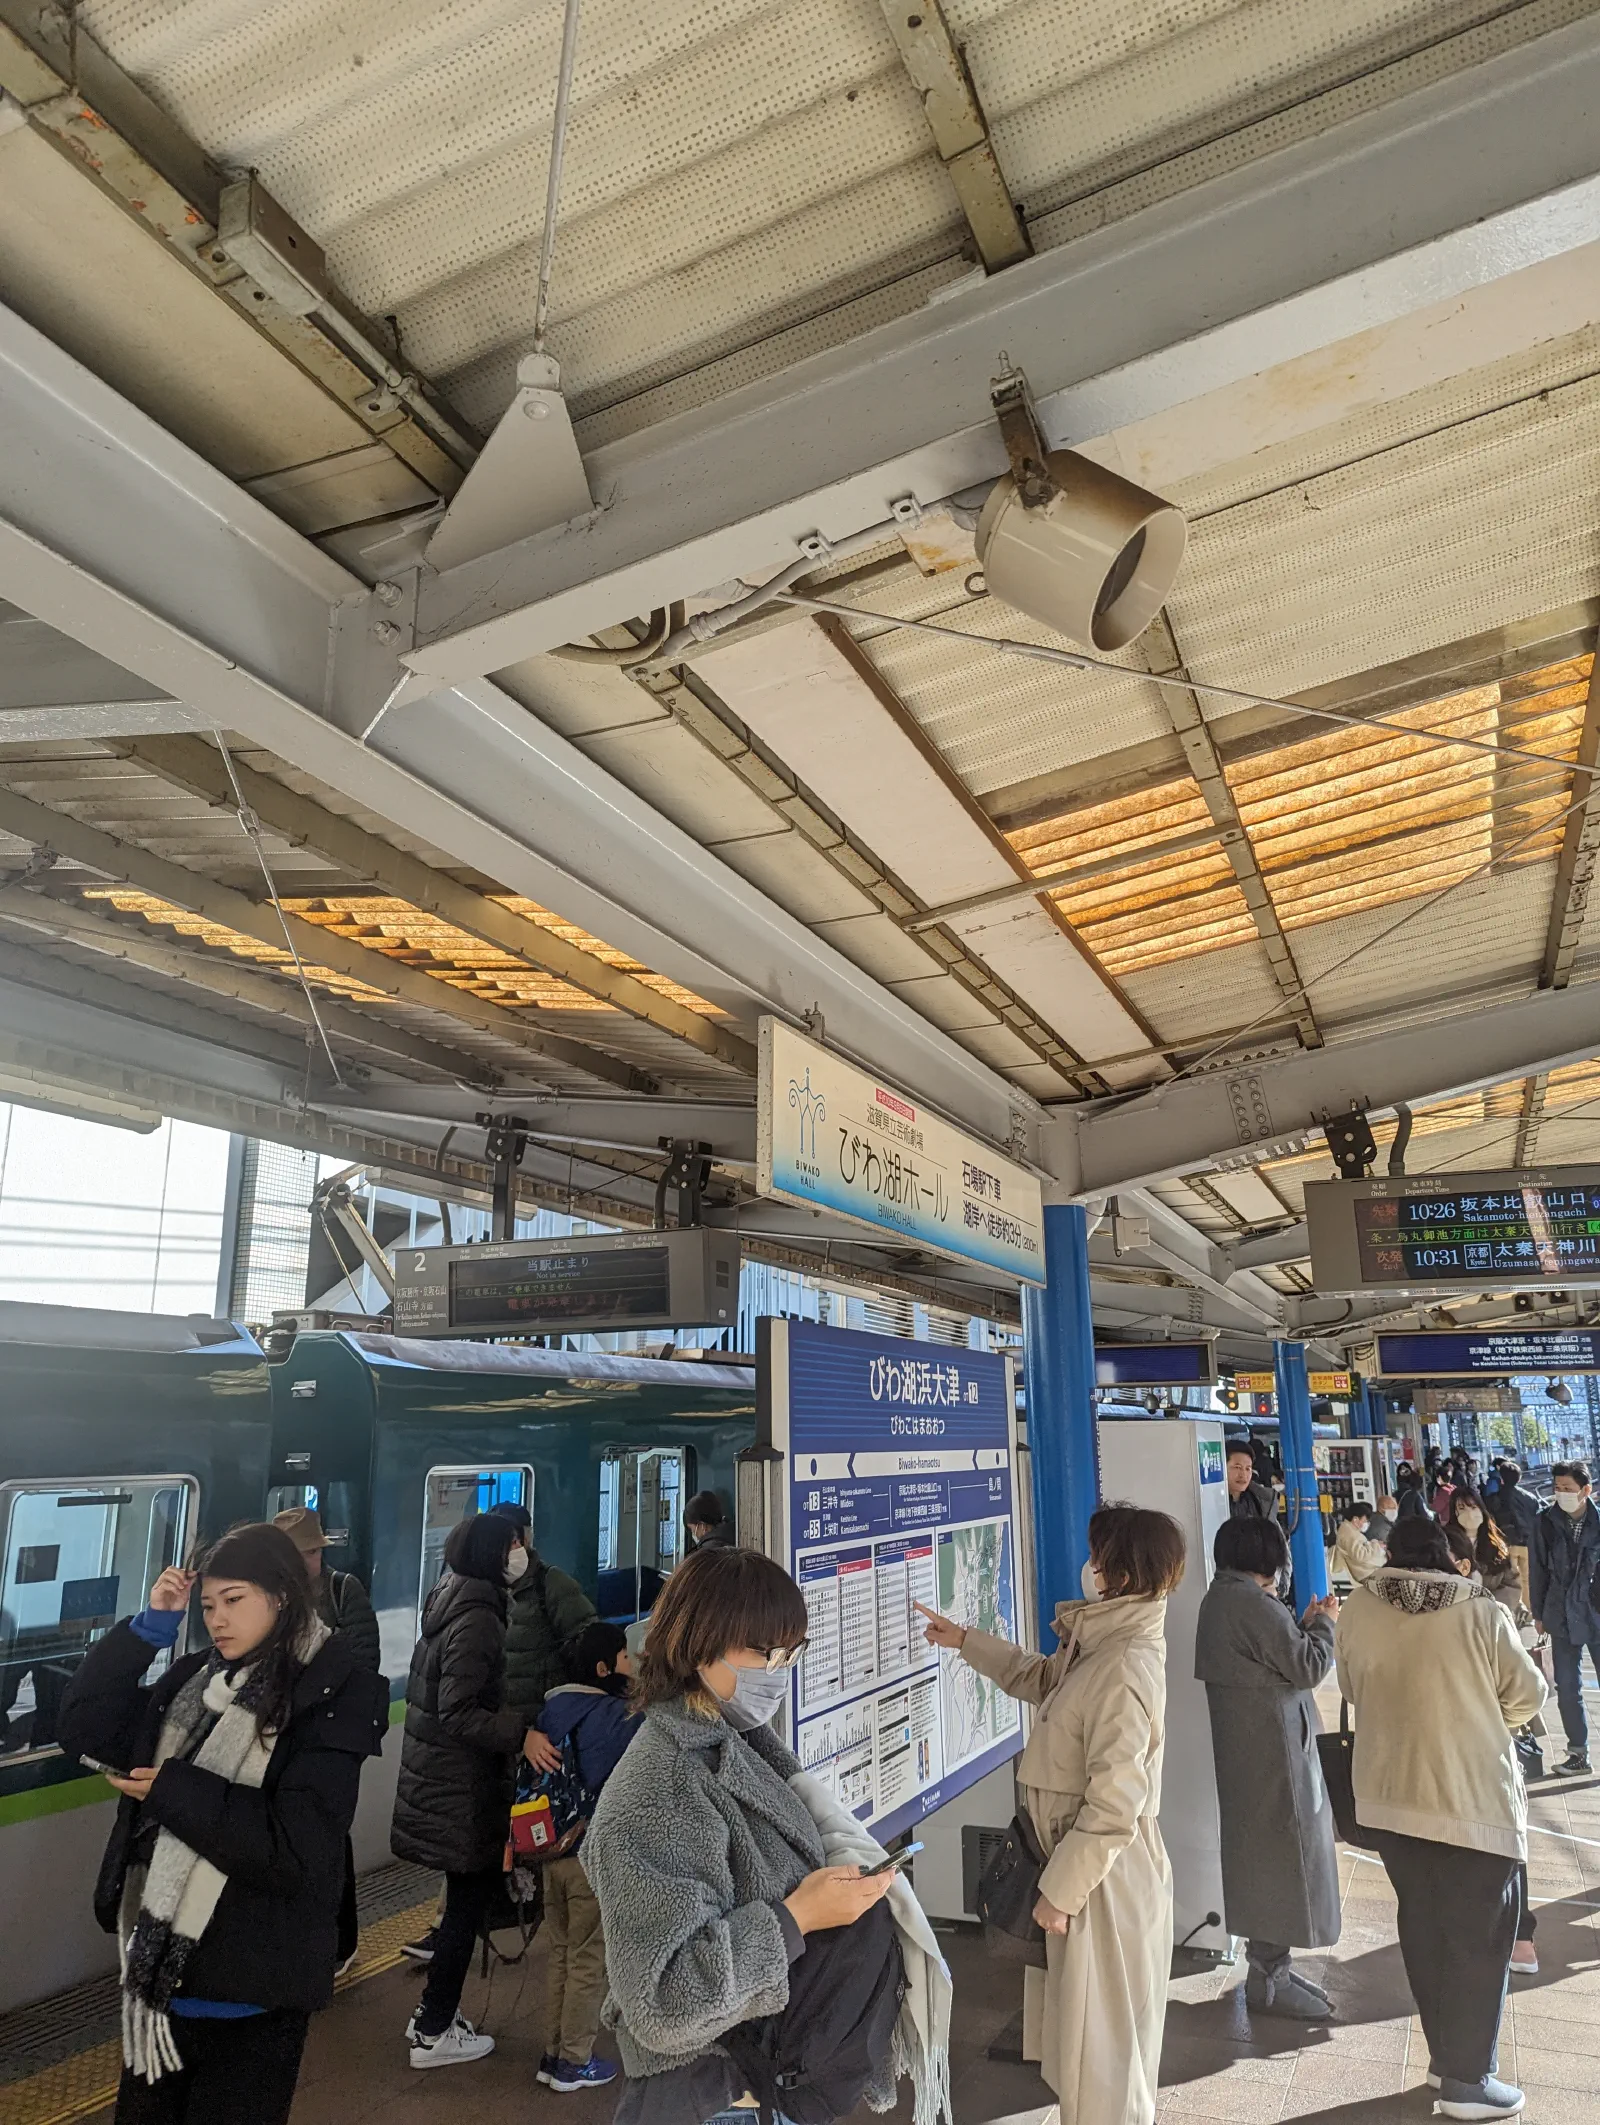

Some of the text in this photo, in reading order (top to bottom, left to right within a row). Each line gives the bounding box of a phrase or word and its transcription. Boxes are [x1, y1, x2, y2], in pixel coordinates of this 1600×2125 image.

[867, 1103, 924, 1151] 滋賀県立芸術劇場
[796, 1160, 820, 1177] BIWAKO
[839, 1127, 948, 1222] びわ湖ホール
[801, 1175, 815, 1189] HALL
[962, 1160, 1001, 1202] 石場駅下車
[1372, 1203, 1398, 1217] 先発
[1409, 1202, 1456, 1220] 10:26
[1460, 1192, 1585, 1211] 坂本比叡山口
[1463, 1207, 1586, 1222] Sakamoto-hieizanguchi
[878, 1204, 917, 1230] BIWAKO HALL
[1366, 1222, 1586, 1243] 条・烏丸御池方面は太秦天神川行き
[414, 1252, 426, 1272] 2
[1376, 1239, 1596, 1266] 次発 10:31 京都 太秦天神川
[1493, 1256, 1600, 1268] Uzumasa-tenjingawa
[528, 1256, 589, 1272] 当駅止まり
[396, 1301, 434, 1312] 石山寺 方面
[870, 1355, 960, 1407] びわ湖浜大津
[890, 1415, 945, 1435] びわこはまおおつ
[899, 1457, 941, 1470] Biwako-hamaotsu
[822, 1496, 838, 1510] 三井寺
[823, 1522, 839, 1537] 上栄町
